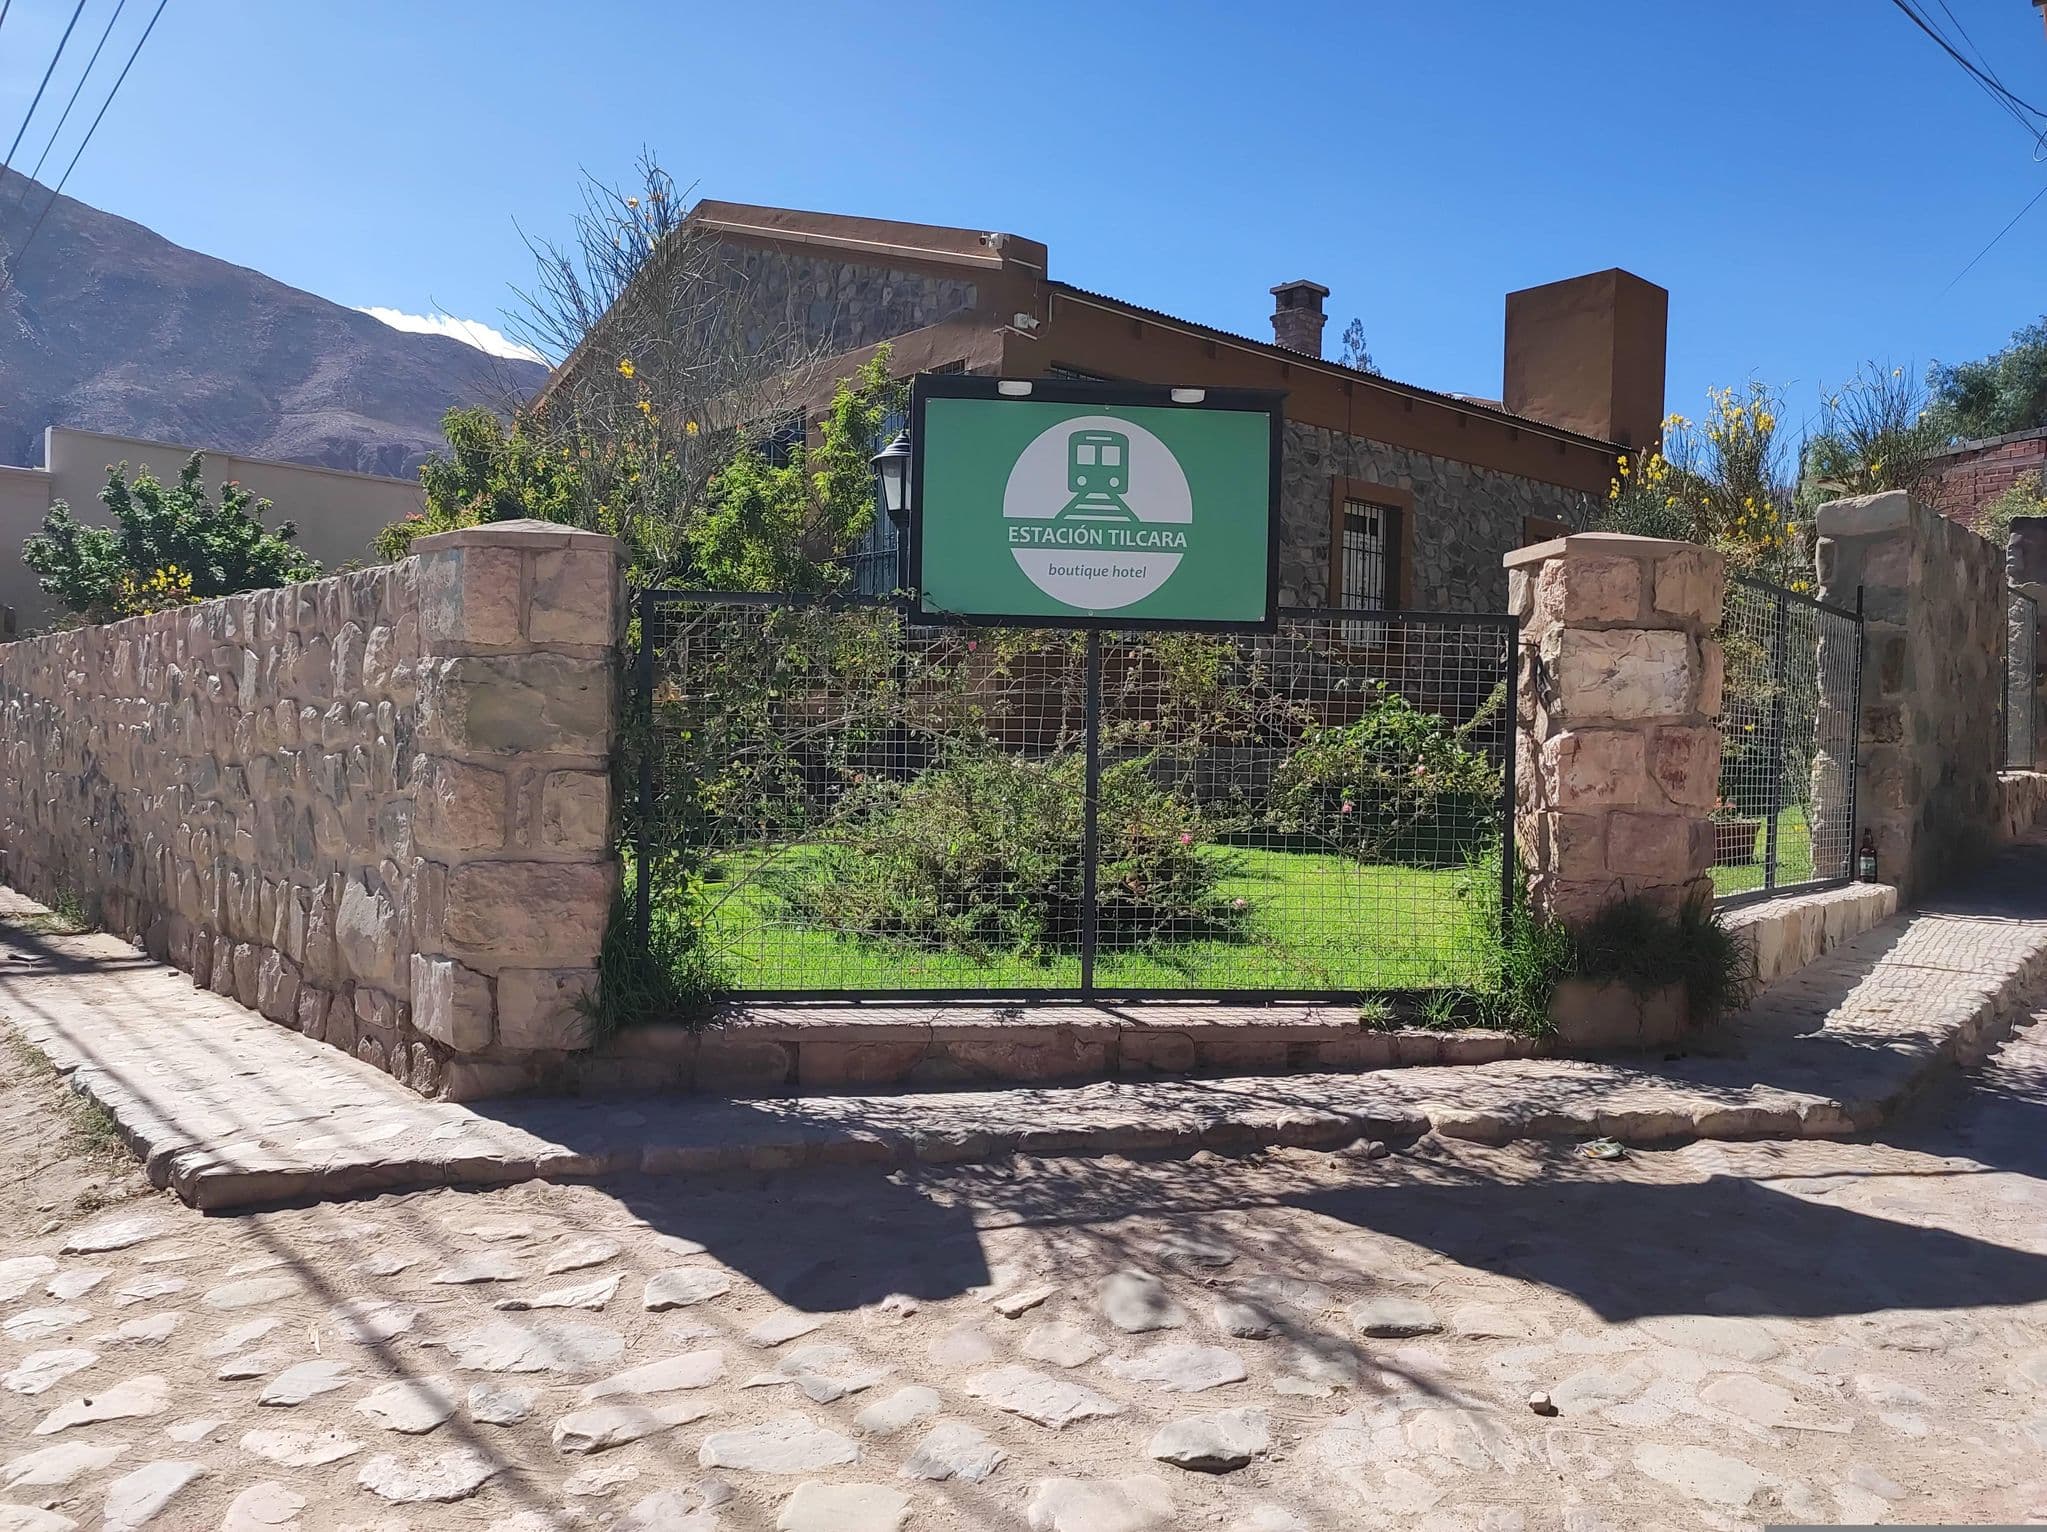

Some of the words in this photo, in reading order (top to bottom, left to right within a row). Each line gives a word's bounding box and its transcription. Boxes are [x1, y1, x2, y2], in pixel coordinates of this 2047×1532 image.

[1008, 525, 1103, 545] ESTACIÓN
[1108, 529, 1187, 548] TILCARA
[1048, 563, 1109, 580] boutique
[1112, 565, 1147, 578] hotel
